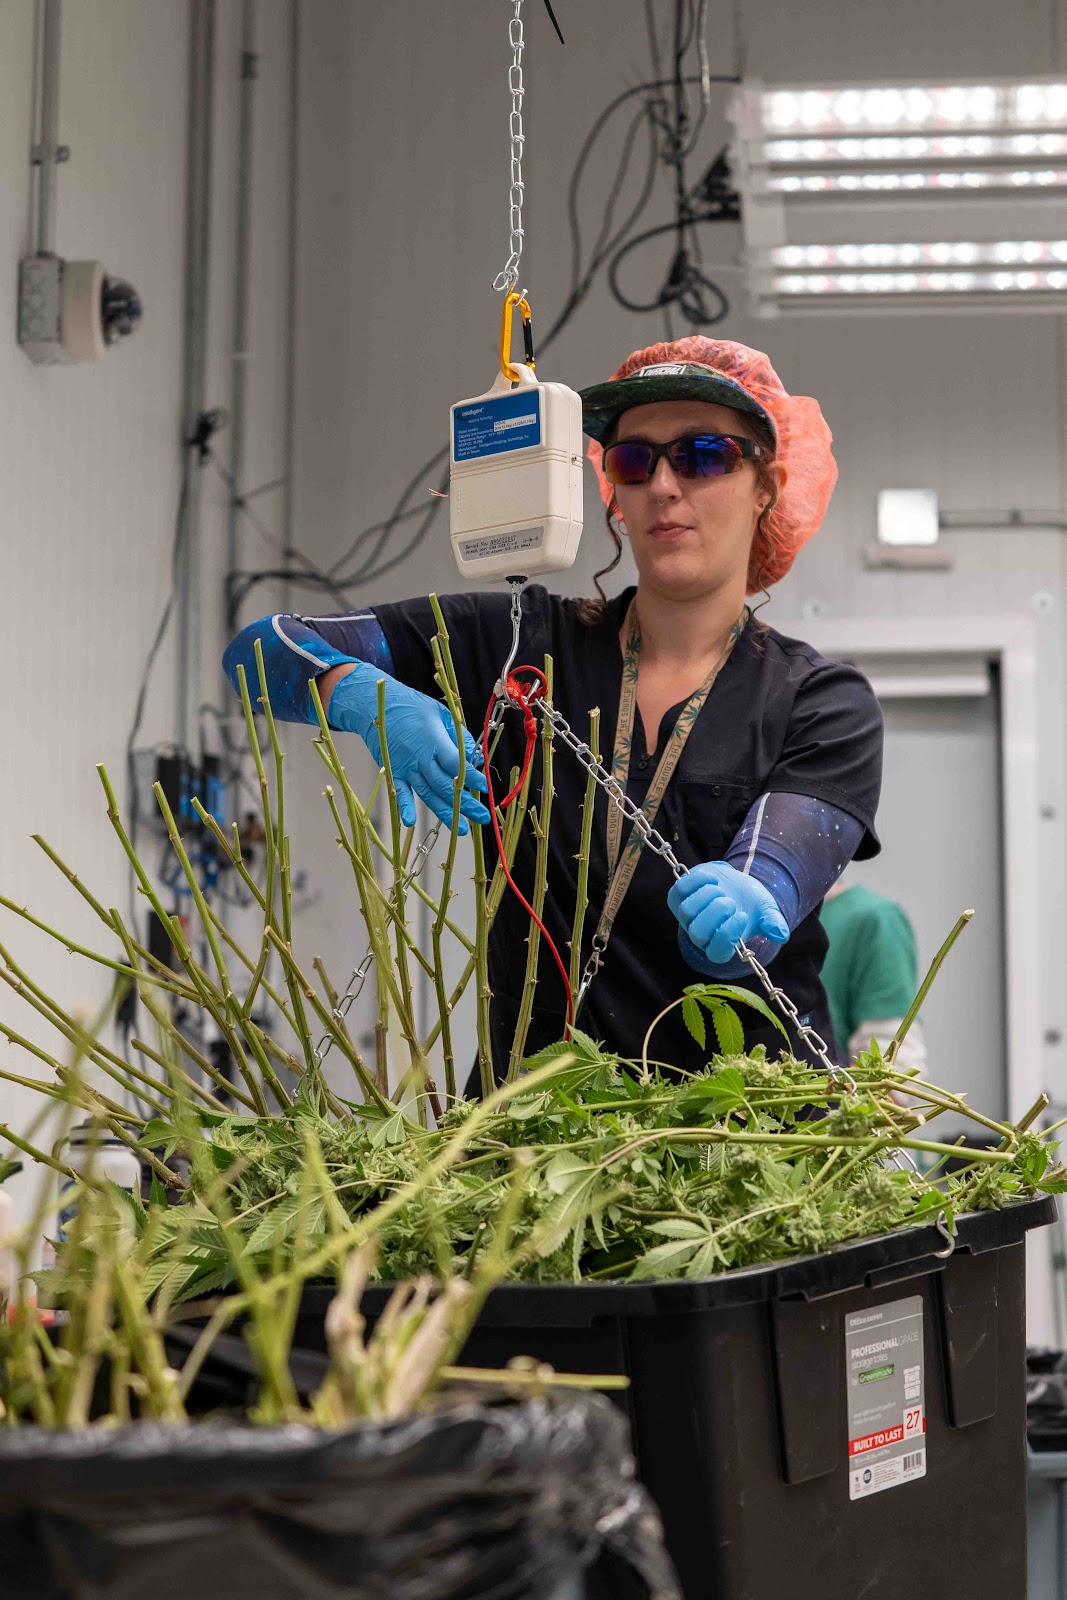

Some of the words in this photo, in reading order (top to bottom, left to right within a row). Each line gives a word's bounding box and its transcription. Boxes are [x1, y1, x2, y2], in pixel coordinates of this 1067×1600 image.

[621, 690, 632, 717] SOURCE
[620, 719, 628, 732] THE
[669, 744, 681, 759] THE
[656, 761, 674, 792] SOURCE
[608, 803, 619, 834] SOURCE
[624, 862, 634, 880] THE
[609, 881, 626, 913] SOURCE
[849, 1316, 866, 1327] Office
[851, 1337, 899, 1359] PROFESSIONAL
[898, 1331, 919, 1346] GRADE
[851, 1356, 873, 1370] storage
[873, 1352, 888, 1364] totes
[906, 1410, 920, 1430] 27
[853, 1437, 873, 1452] BUILT
[873, 1434, 884, 1445] TO
[885, 1428, 902, 1442] LAST
